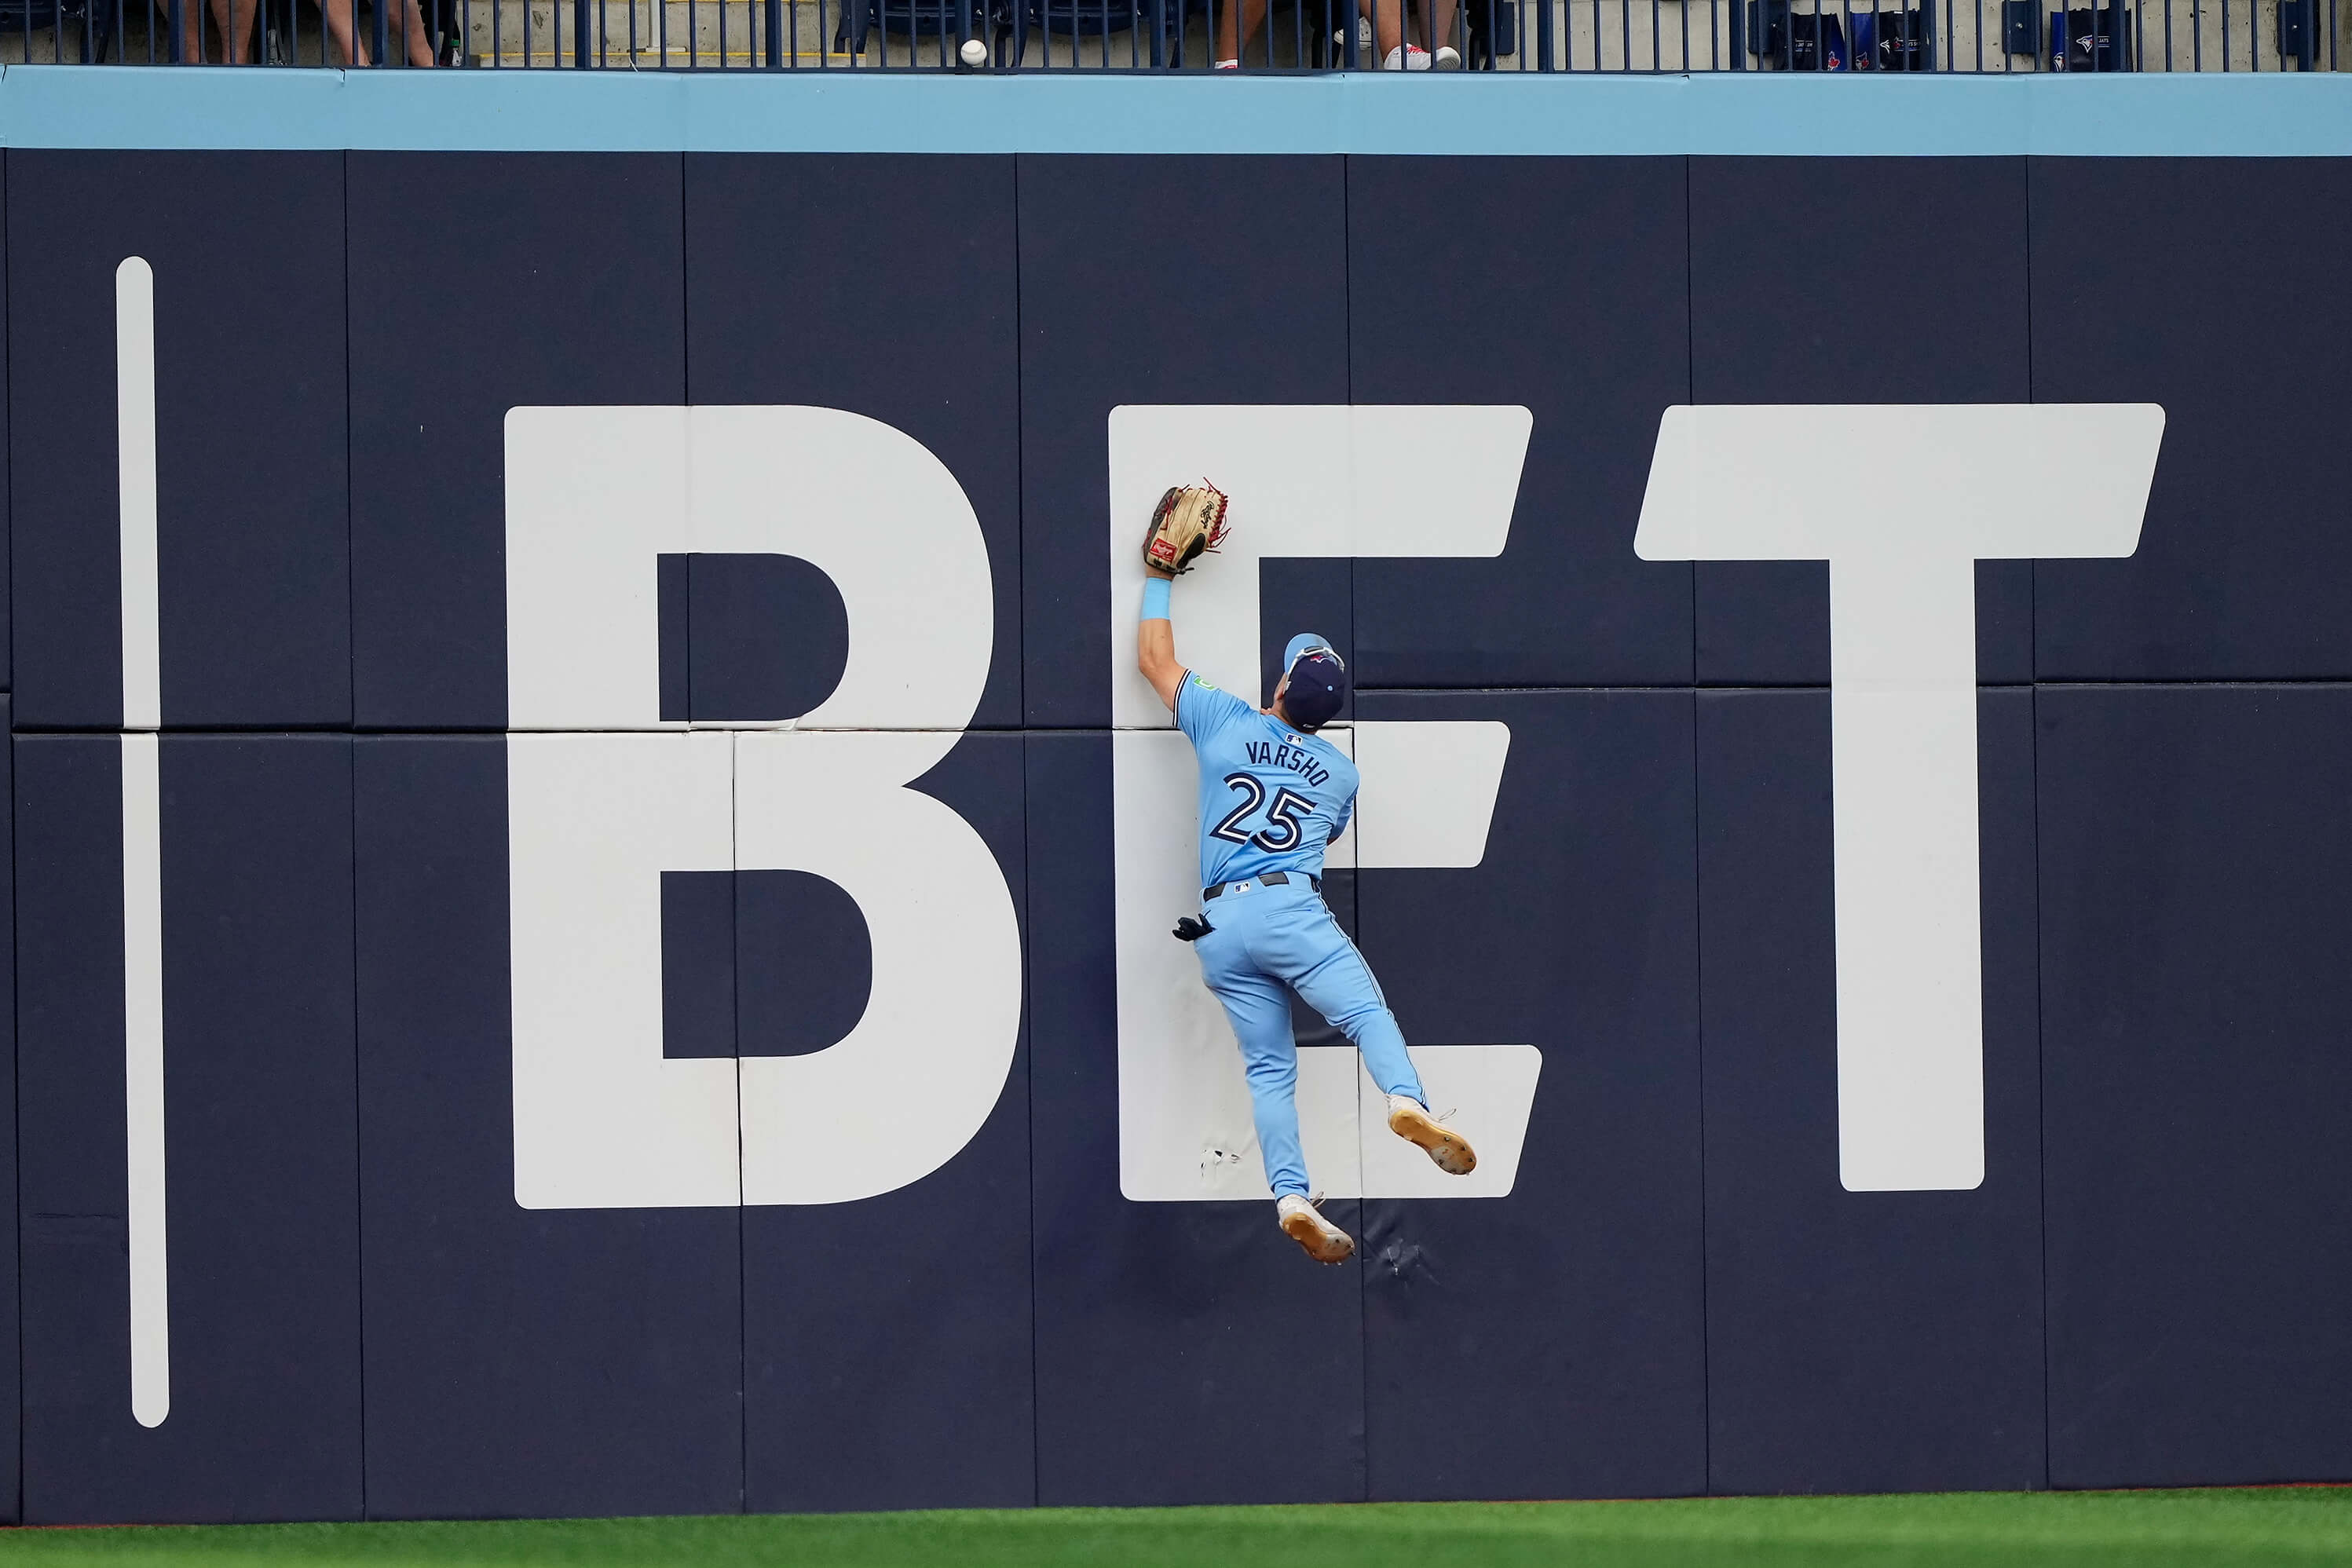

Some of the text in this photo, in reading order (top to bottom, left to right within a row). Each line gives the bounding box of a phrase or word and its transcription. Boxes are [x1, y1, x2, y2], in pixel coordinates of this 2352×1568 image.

[1245, 741, 1330, 788] VARSHO
[504, 403, 2166, 1210] BET
[1209, 772, 1319, 854] 25
